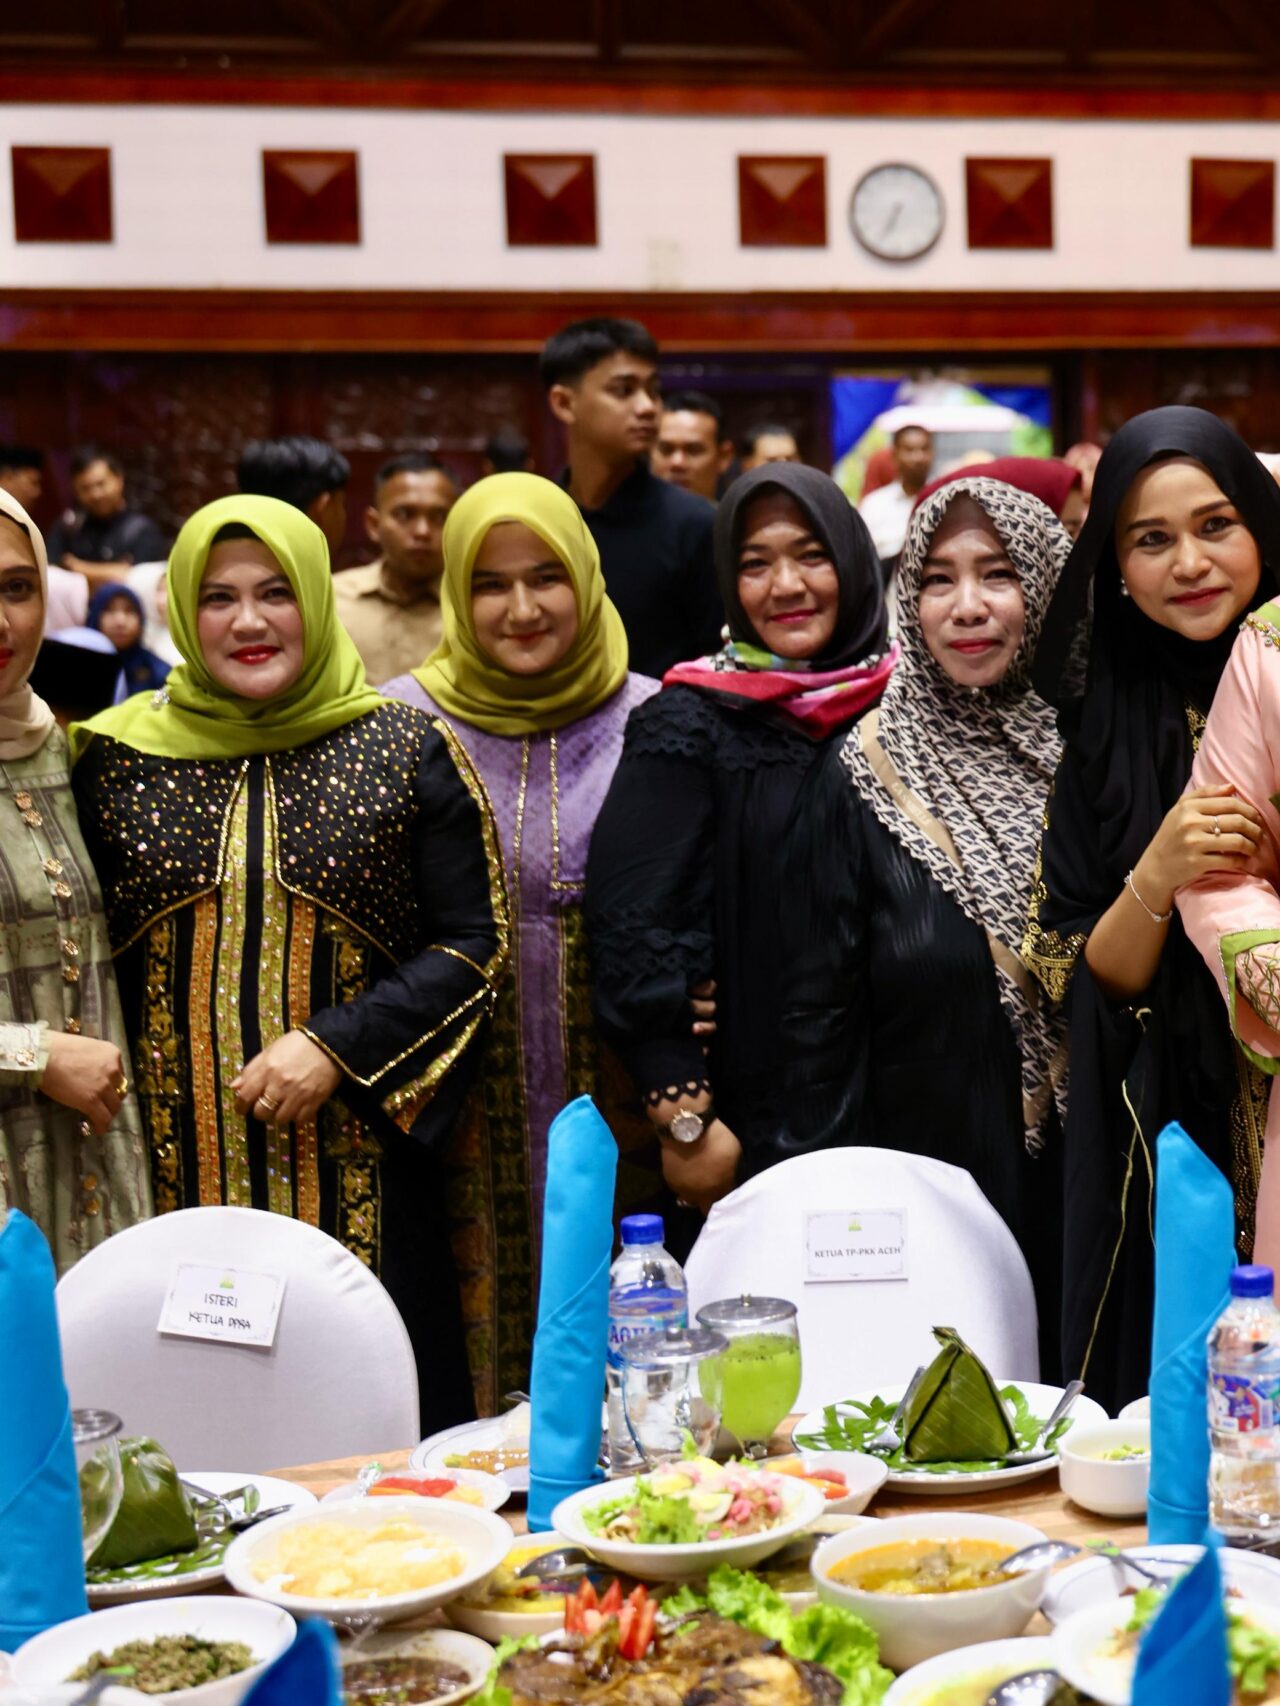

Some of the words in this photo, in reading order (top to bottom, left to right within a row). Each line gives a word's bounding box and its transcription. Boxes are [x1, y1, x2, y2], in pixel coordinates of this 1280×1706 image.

[814, 1249, 844, 1258] KETUA
[845, 1248, 876, 1257] TP-PKK
[877, 1246, 901, 1256] ACEH
[204, 1293, 238, 1308] ISTERI
[188, 1311, 224, 1327] KETUA
